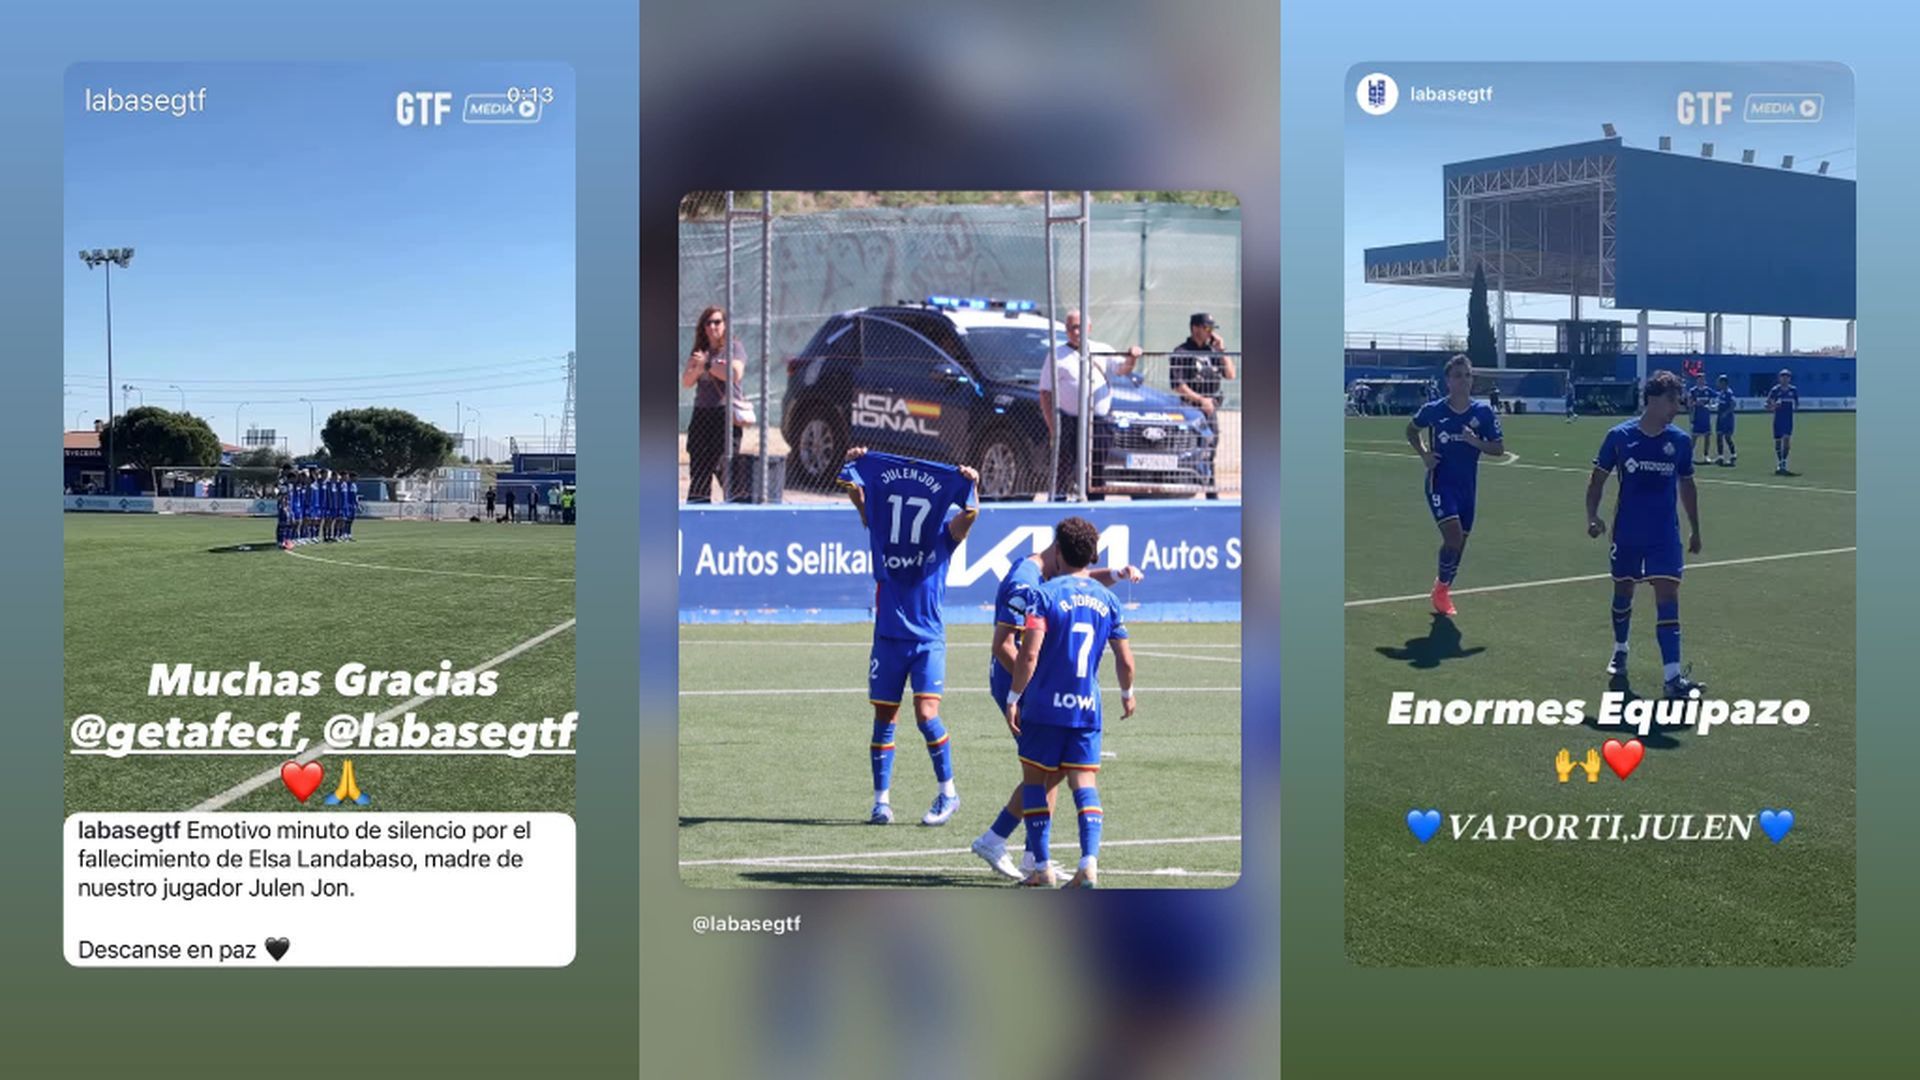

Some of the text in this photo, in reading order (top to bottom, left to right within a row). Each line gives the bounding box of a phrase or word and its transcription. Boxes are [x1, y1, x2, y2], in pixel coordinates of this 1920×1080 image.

[887, 494, 932, 545] 17
[694, 543, 779, 576] Autos
[1141, 538, 1220, 571] Autos
[1071, 622, 1095, 678] 7
